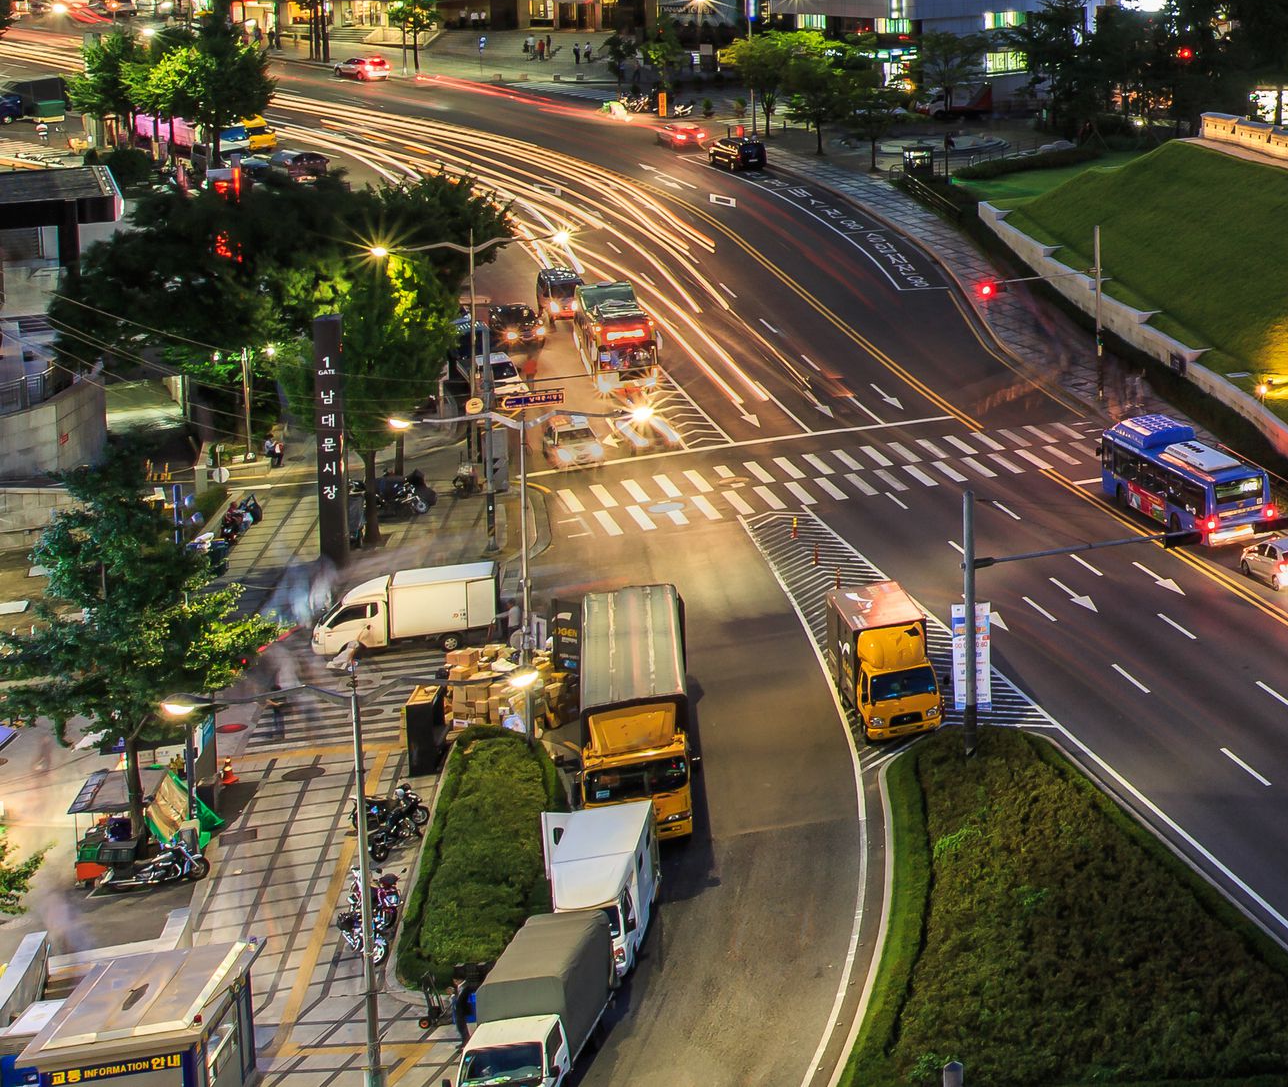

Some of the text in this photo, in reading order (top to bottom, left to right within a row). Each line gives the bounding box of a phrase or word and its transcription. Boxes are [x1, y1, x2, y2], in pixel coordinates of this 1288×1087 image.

[322, 356, 330, 368] 1
[320, 389, 338, 500] 남대문시장
[51, 1054, 181, 1086] 교통 INFORMATION 안내
